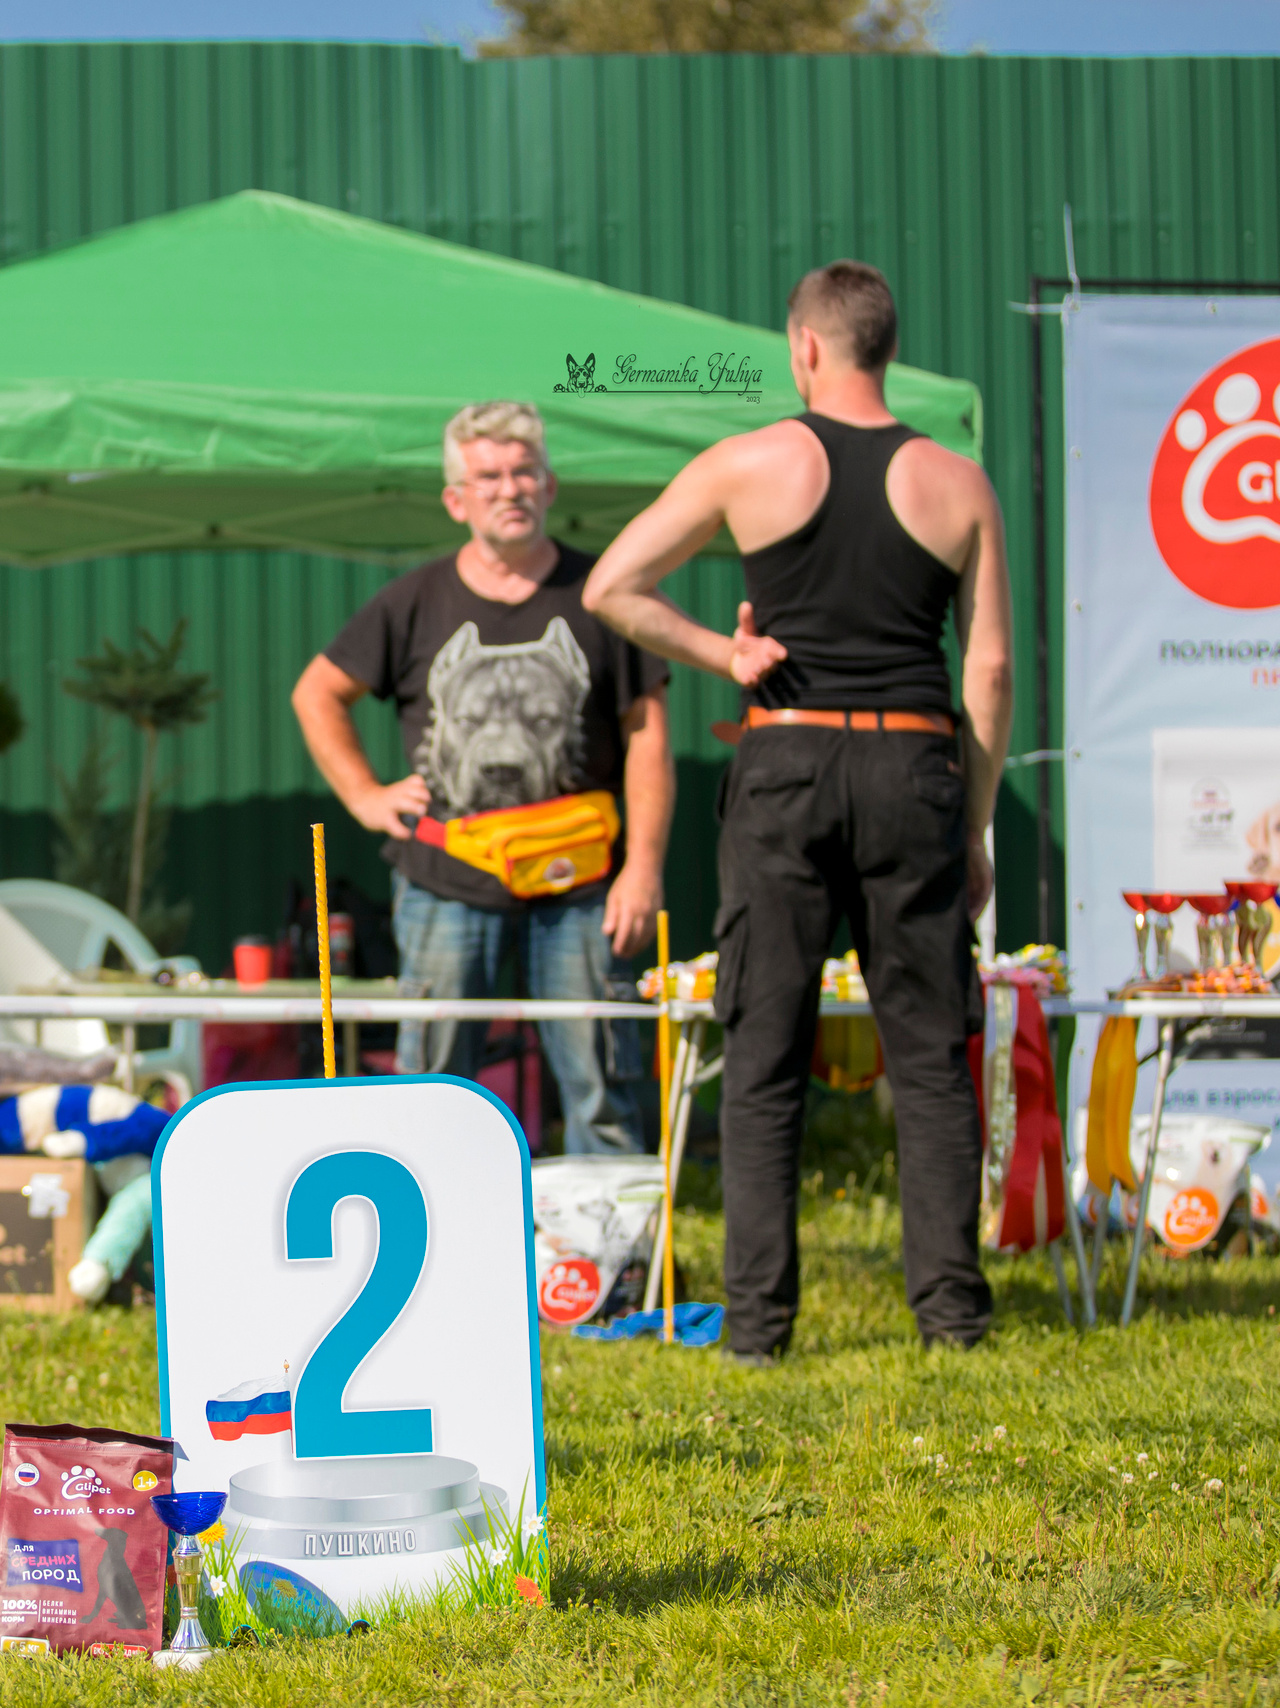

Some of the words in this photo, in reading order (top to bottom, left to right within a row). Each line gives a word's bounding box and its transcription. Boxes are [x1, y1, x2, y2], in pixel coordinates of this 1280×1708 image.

[284, 1149, 435, 1461] 2
[137, 1476, 154, 1488] 1+
[33, 1506, 93, 1516] OPTIMAL
[99, 1507, 135, 1516] FOOD
[304, 1528, 416, 1556] ПУШКИНО
[11, 1554, 77, 1568] СРЕДНИХ
[22, 1568, 81, 1584] ПОРОД
[2, 1599, 38, 1610] 100%
[42, 1608, 77, 1616] ВИТАМИНЫ
[1, 1615, 25, 1623] КОРМ
[42, 1616, 77, 1625] МИНЕРАЛЫ
